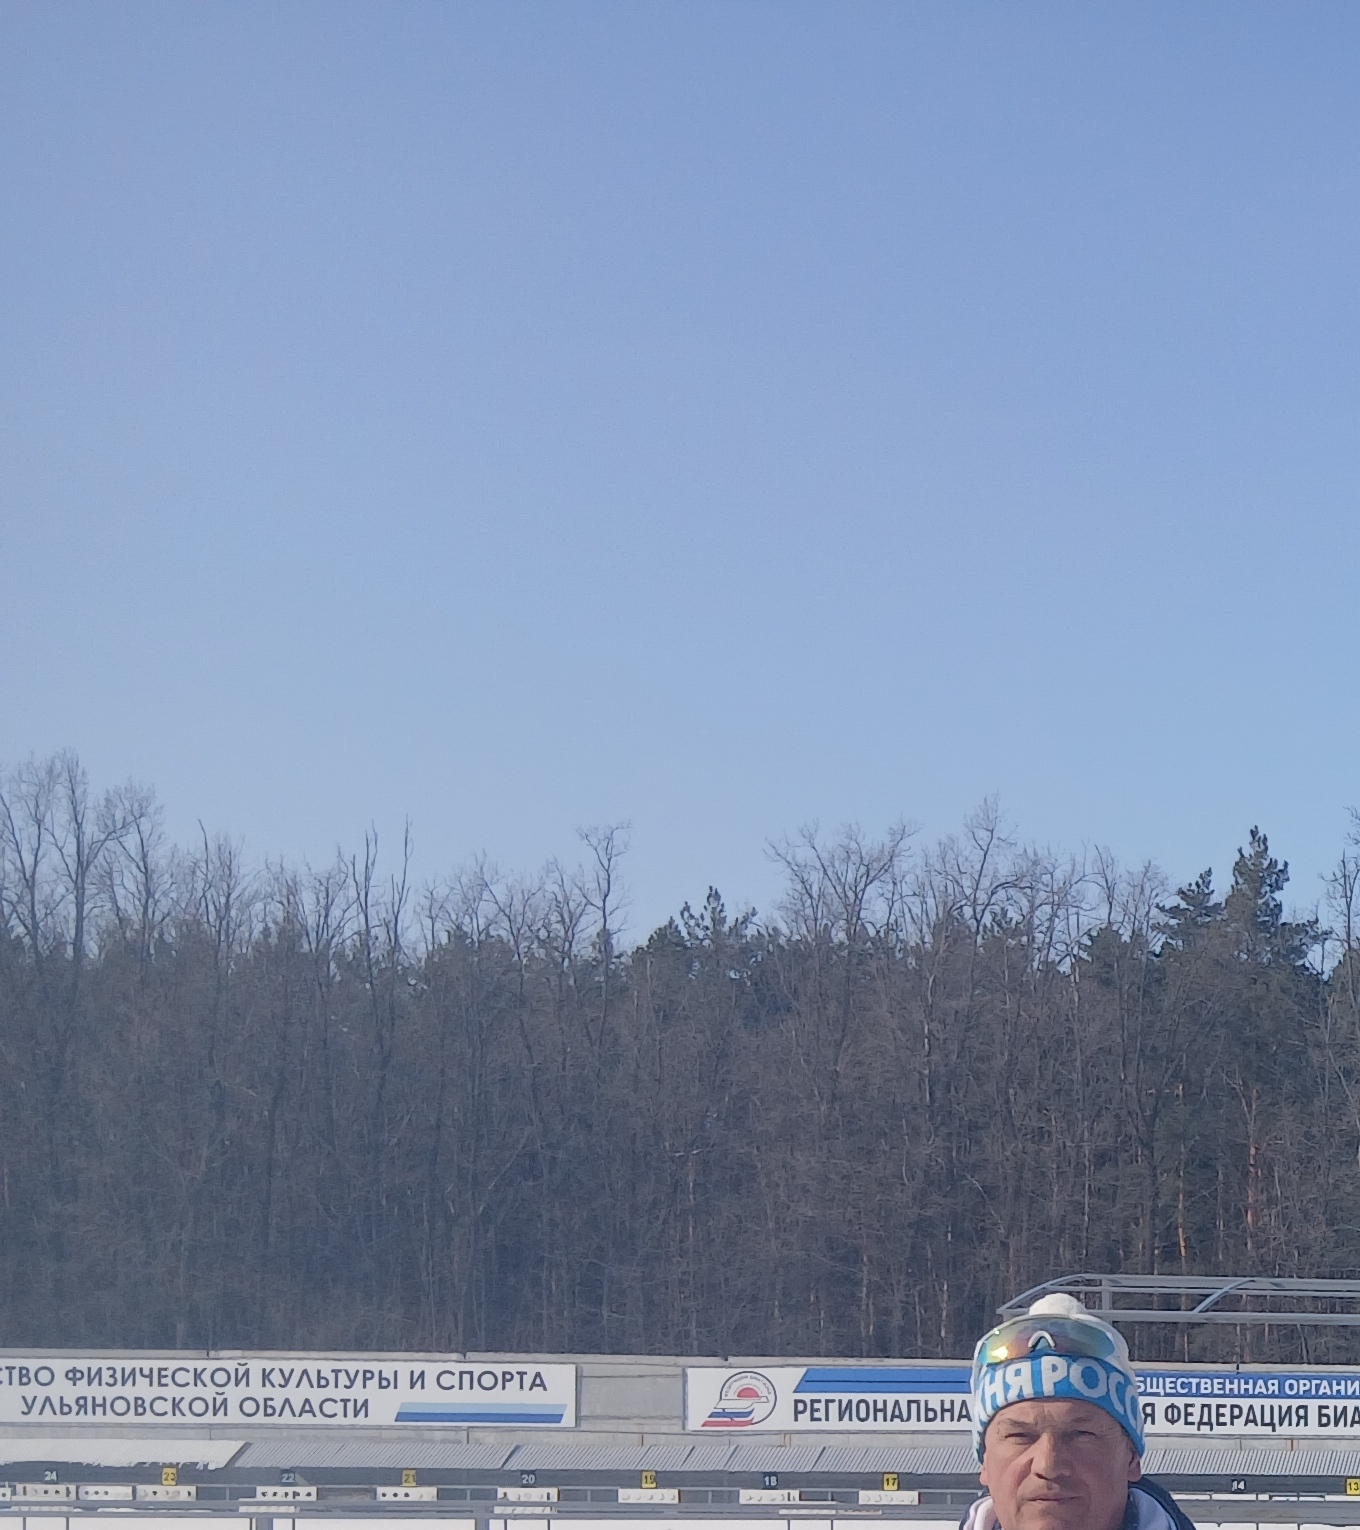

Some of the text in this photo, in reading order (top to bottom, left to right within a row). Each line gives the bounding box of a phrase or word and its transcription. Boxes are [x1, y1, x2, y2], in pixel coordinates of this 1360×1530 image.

[0, 1362, 548, 1392] ТВО ФИЗИЧЕСКОЙ КУЛЬТУРЫ И СПОРТА
[1136, 1376, 1279, 1397] БЩЕСТВЕННАЯ
[21, 1391, 370, 1419] УЛЬЯНОВСКОЙ ОБЛАСТИ
[793, 1398, 973, 1424] РЕГИОНАЛЬНА
[1164, 1402, 1307, 1433] ФЕДЕРАЦИЯ
[522, 1474, 535, 1484] 20
[885, 1477, 896, 1486] 17
[1348, 1481, 1359, 1491] 13
